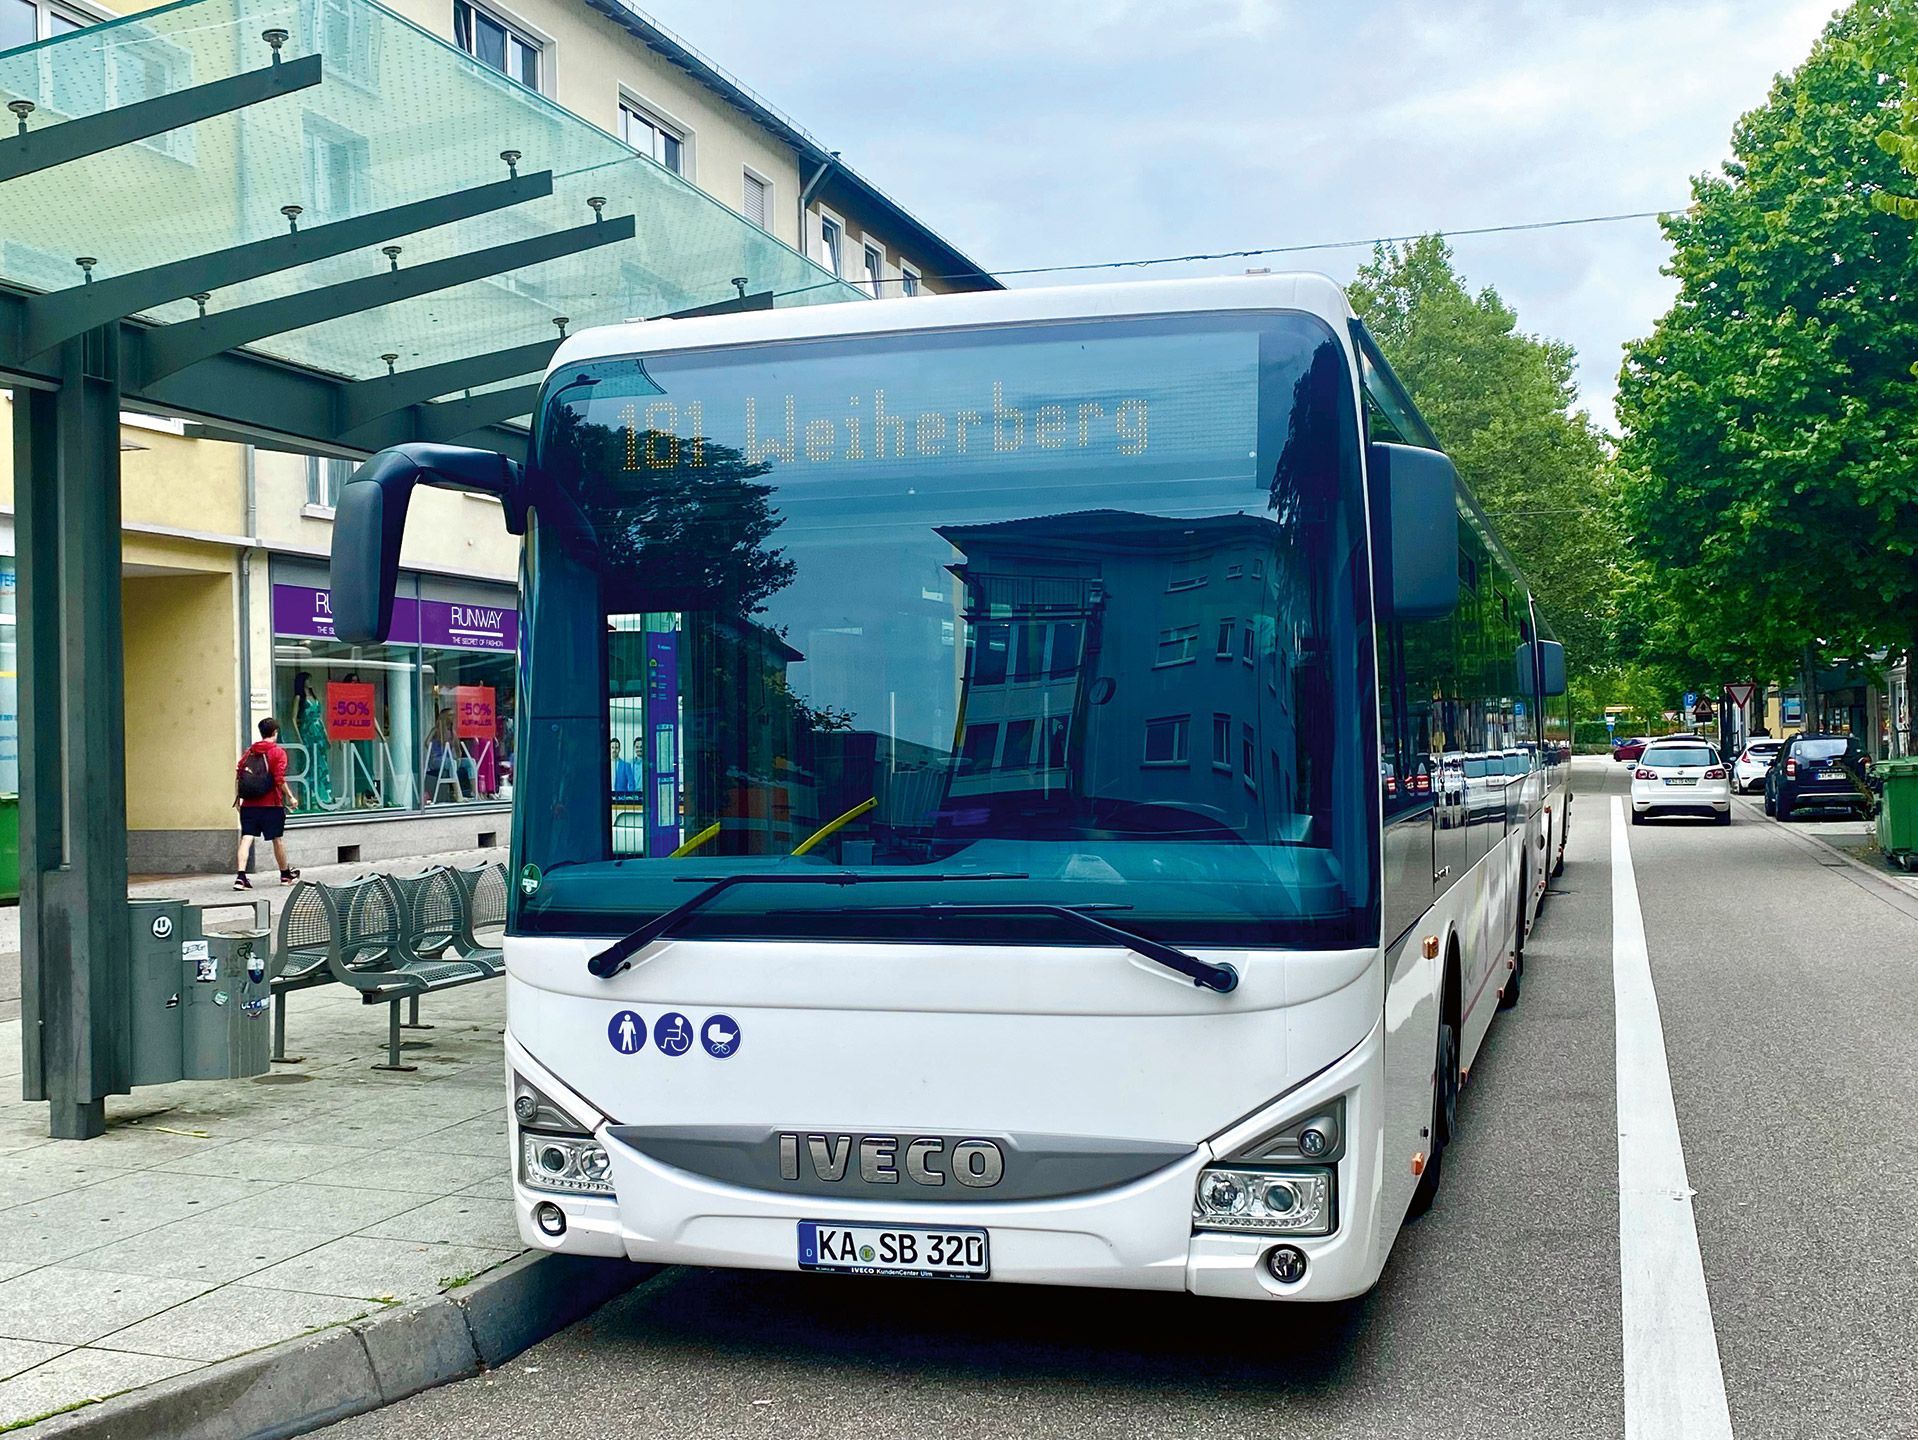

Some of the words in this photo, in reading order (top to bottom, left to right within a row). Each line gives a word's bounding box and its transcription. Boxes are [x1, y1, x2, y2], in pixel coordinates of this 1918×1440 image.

[616, 401, 707, 471] 181
[745, 380, 1148, 465] Weiherberg
[451, 606, 503, 629] RUNWAY
[332, 700, 370, 716] -50%
[460, 702, 492, 716] -50%
[279, 741, 491, 812] RUNWAY
[779, 1134, 1005, 1188] IVECO
[818, 1230, 858, 1262] KA
[879, 1233, 918, 1264] SB
[926, 1234, 984, 1267] 320
[851, 1267, 875, 1275] IVECO
[876, 1268, 919, 1277] KundenCenter
[920, 1269, 933, 1277] Ulm
